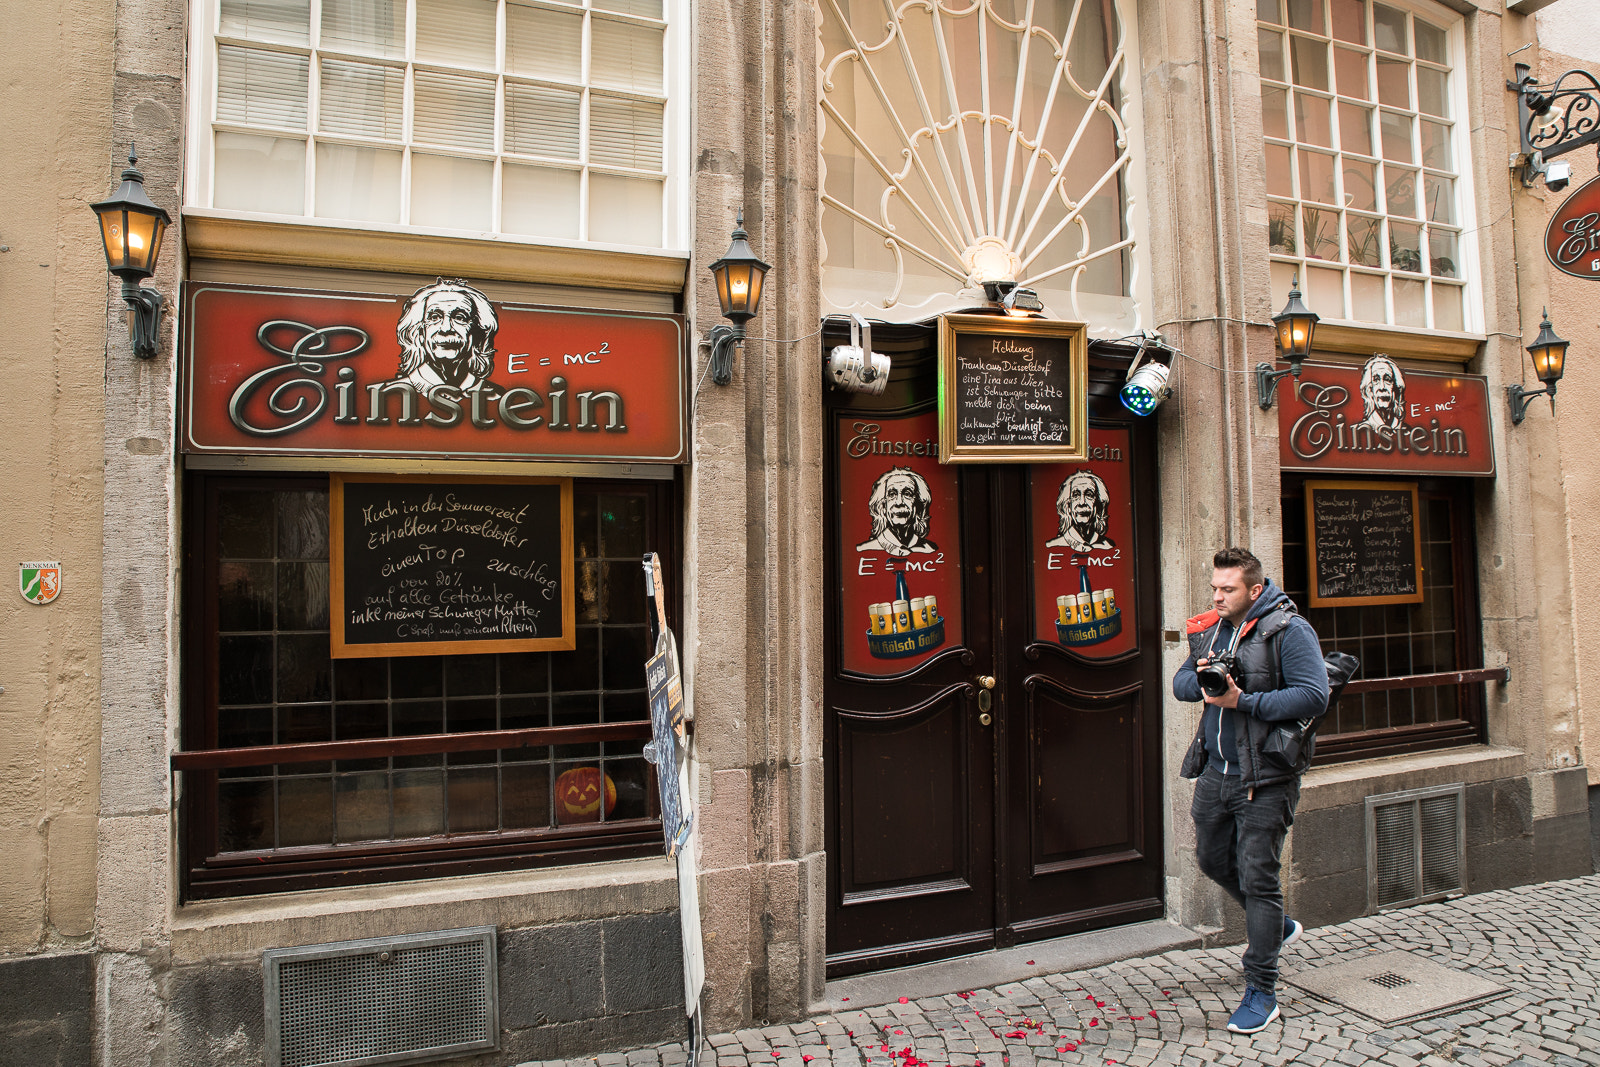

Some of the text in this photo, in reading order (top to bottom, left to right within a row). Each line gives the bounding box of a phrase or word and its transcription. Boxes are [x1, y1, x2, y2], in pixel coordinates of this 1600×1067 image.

[992, 339, 1034, 362] Achtung
[507, 352, 530, 374] E
[986, 363, 1002, 372] aus
[1002, 360, 1052, 376] Düsseldorf
[228, 319, 629, 434] Einstein
[962, 372, 1044, 388] eine Tina aus Wien
[966, 386, 980, 396] ist
[1034, 385, 1063, 399] bitte
[964, 397, 1052, 412] melde dich beim
[1410, 403, 1421, 418] E
[1290, 382, 1468, 459] Einstein
[976, 428, 997, 444] geht
[1000, 433, 1016, 441] nur
[1039, 431, 1064, 442] Geld
[362, 493, 530, 527] Auch in der Sommerzeit
[368, 516, 529, 550] Erhalten Düsseldorfer
[858, 556, 878, 576] E
[1047, 553, 1064, 570] E
[381, 554, 423, 578] einen
[486, 558, 558, 601] zuschlag
[400, 570, 463, 589] von 20%
[364, 583, 515, 608] auf alle Getränke
[351, 601, 541, 625] inkl meiner Schwieger Mutter
[1069, 627, 1097, 642] Kölsch
[882, 637, 916, 654] Kölsch
